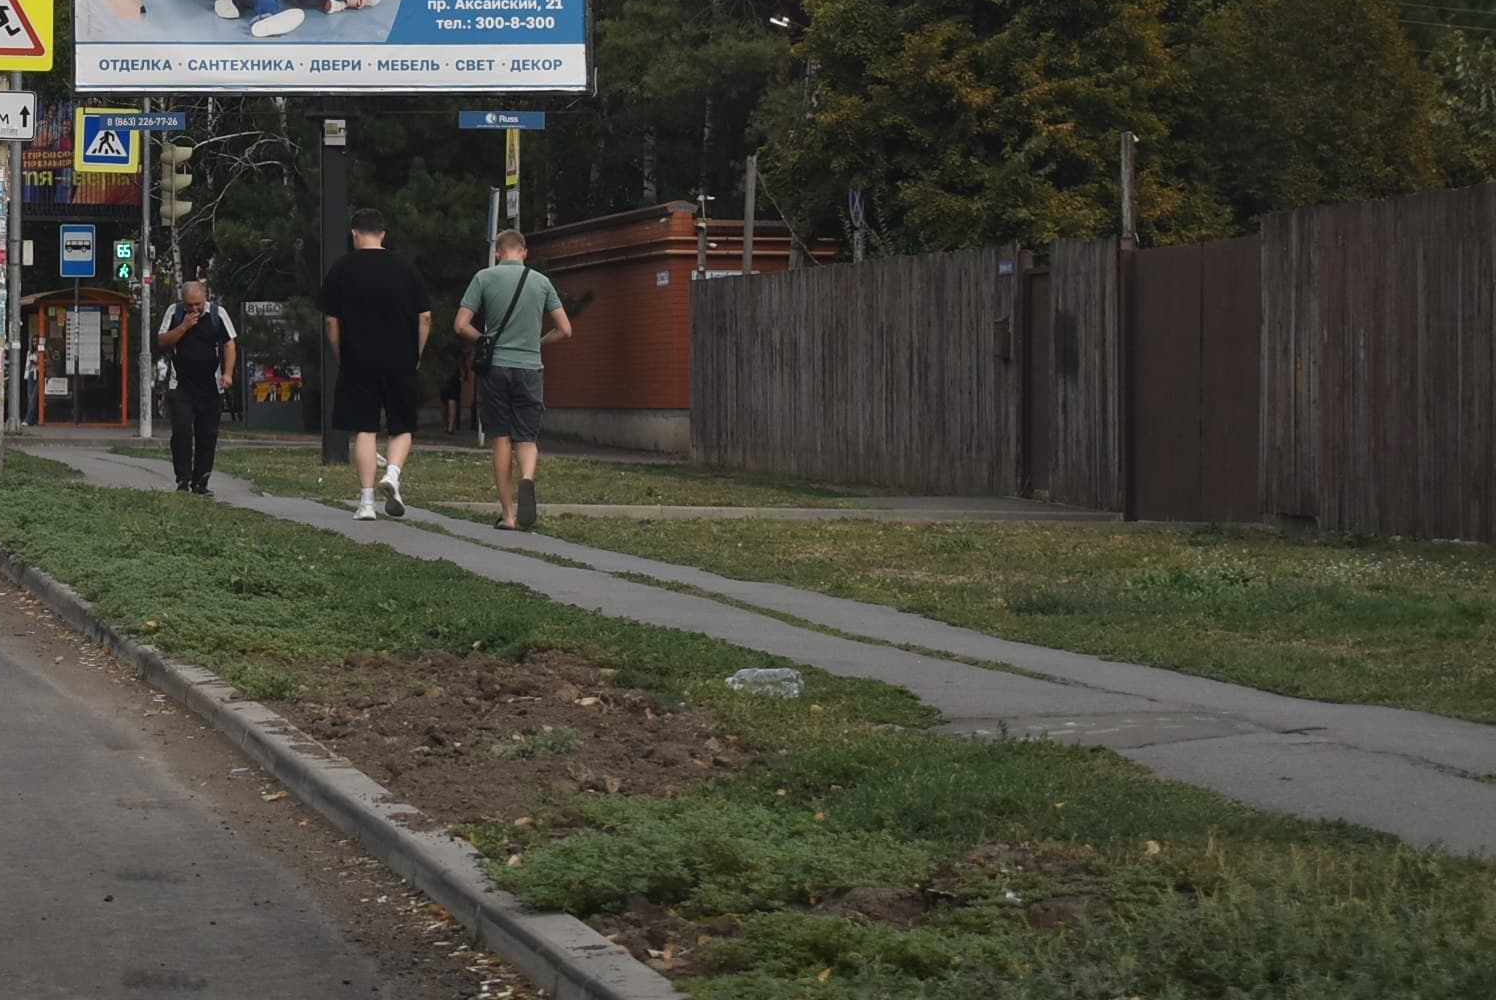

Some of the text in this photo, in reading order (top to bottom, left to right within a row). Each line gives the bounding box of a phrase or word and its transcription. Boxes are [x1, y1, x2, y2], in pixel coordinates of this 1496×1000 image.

[427, 0, 451, 12] пр.
[435, 16, 556, 29] тел.: 300-8-300
[98, 58, 563, 73] ОТДЕЛКА САНТЕХНИКА ДВЕРИ МЕБЕЛЬ СВЕТ ДЕКОР
[107, 116, 178, 128] 8 (863) 226-77-26
[117, 244, 131, 258] 65
